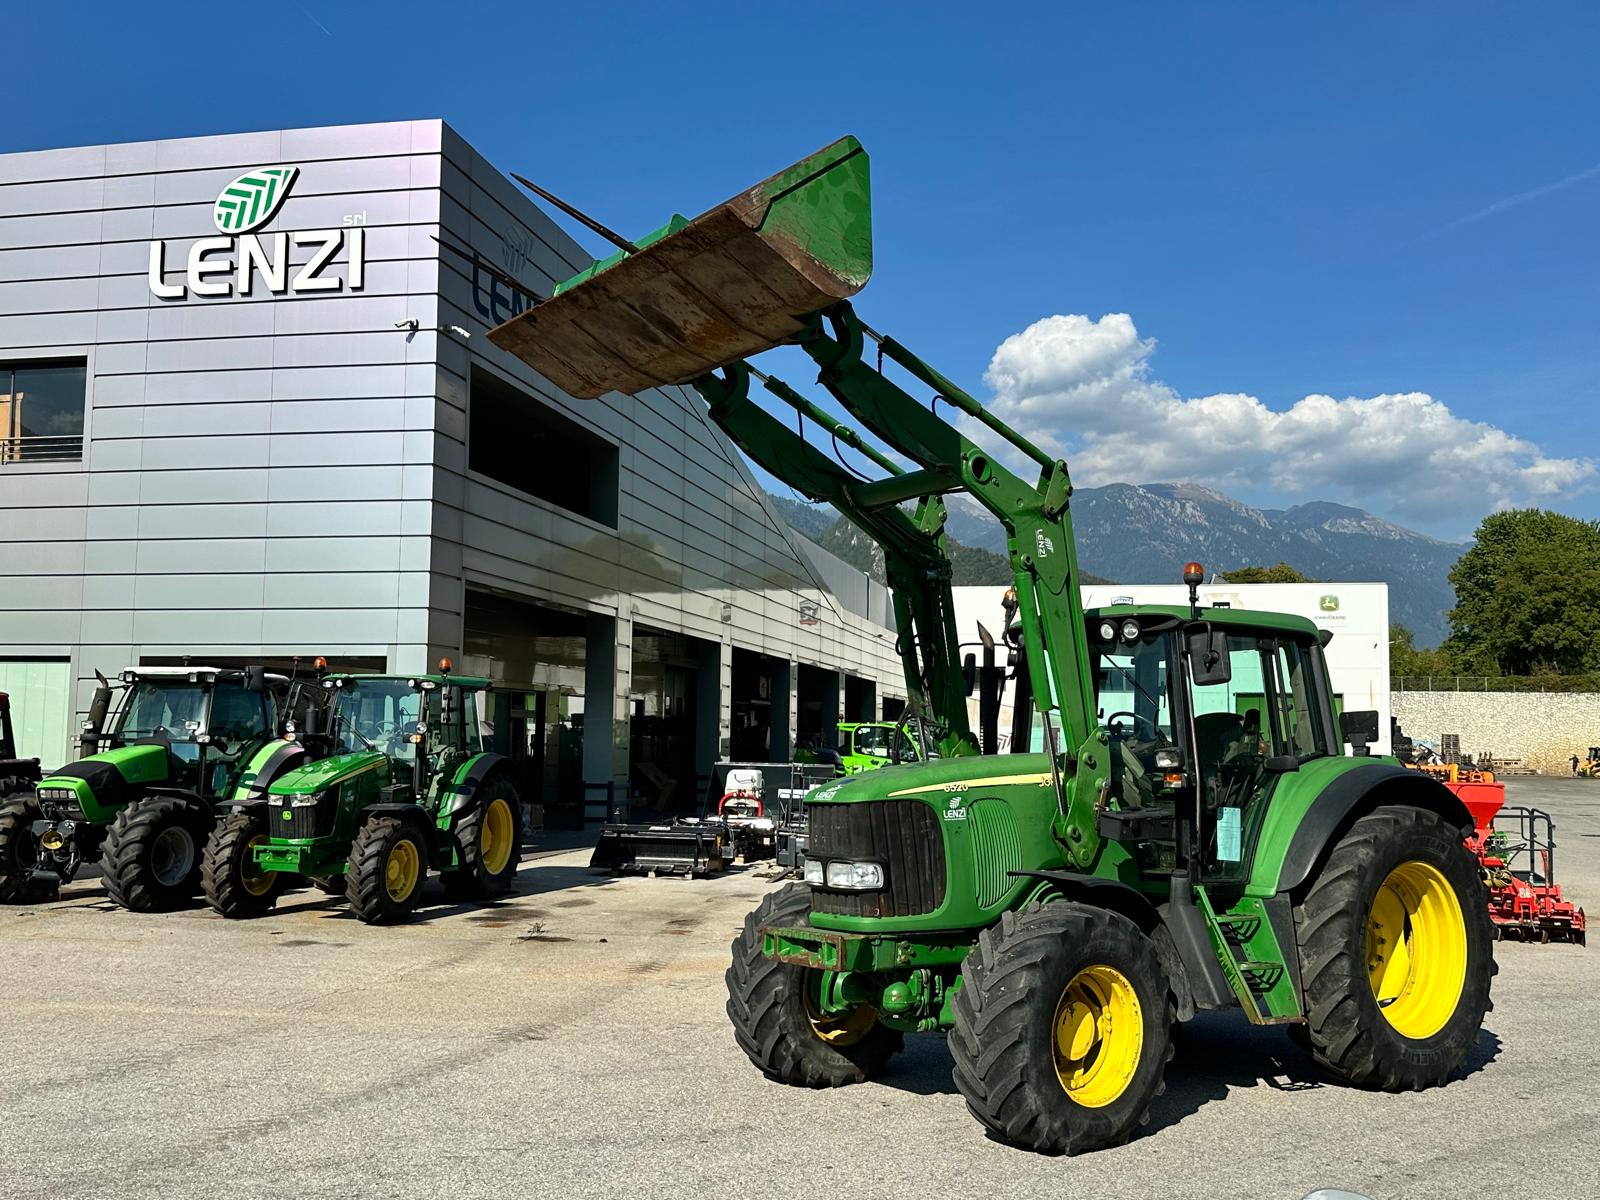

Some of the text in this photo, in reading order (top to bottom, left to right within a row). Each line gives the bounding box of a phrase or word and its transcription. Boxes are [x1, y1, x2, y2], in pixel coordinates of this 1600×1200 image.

[343, 210, 367, 225] srl
[148, 228, 364, 299] LENZI
[473, 252, 538, 325] LEN
[1037, 529, 1047, 557] LENZI
[944, 783, 969, 793] 6520
[943, 808, 967, 818] LENZI
